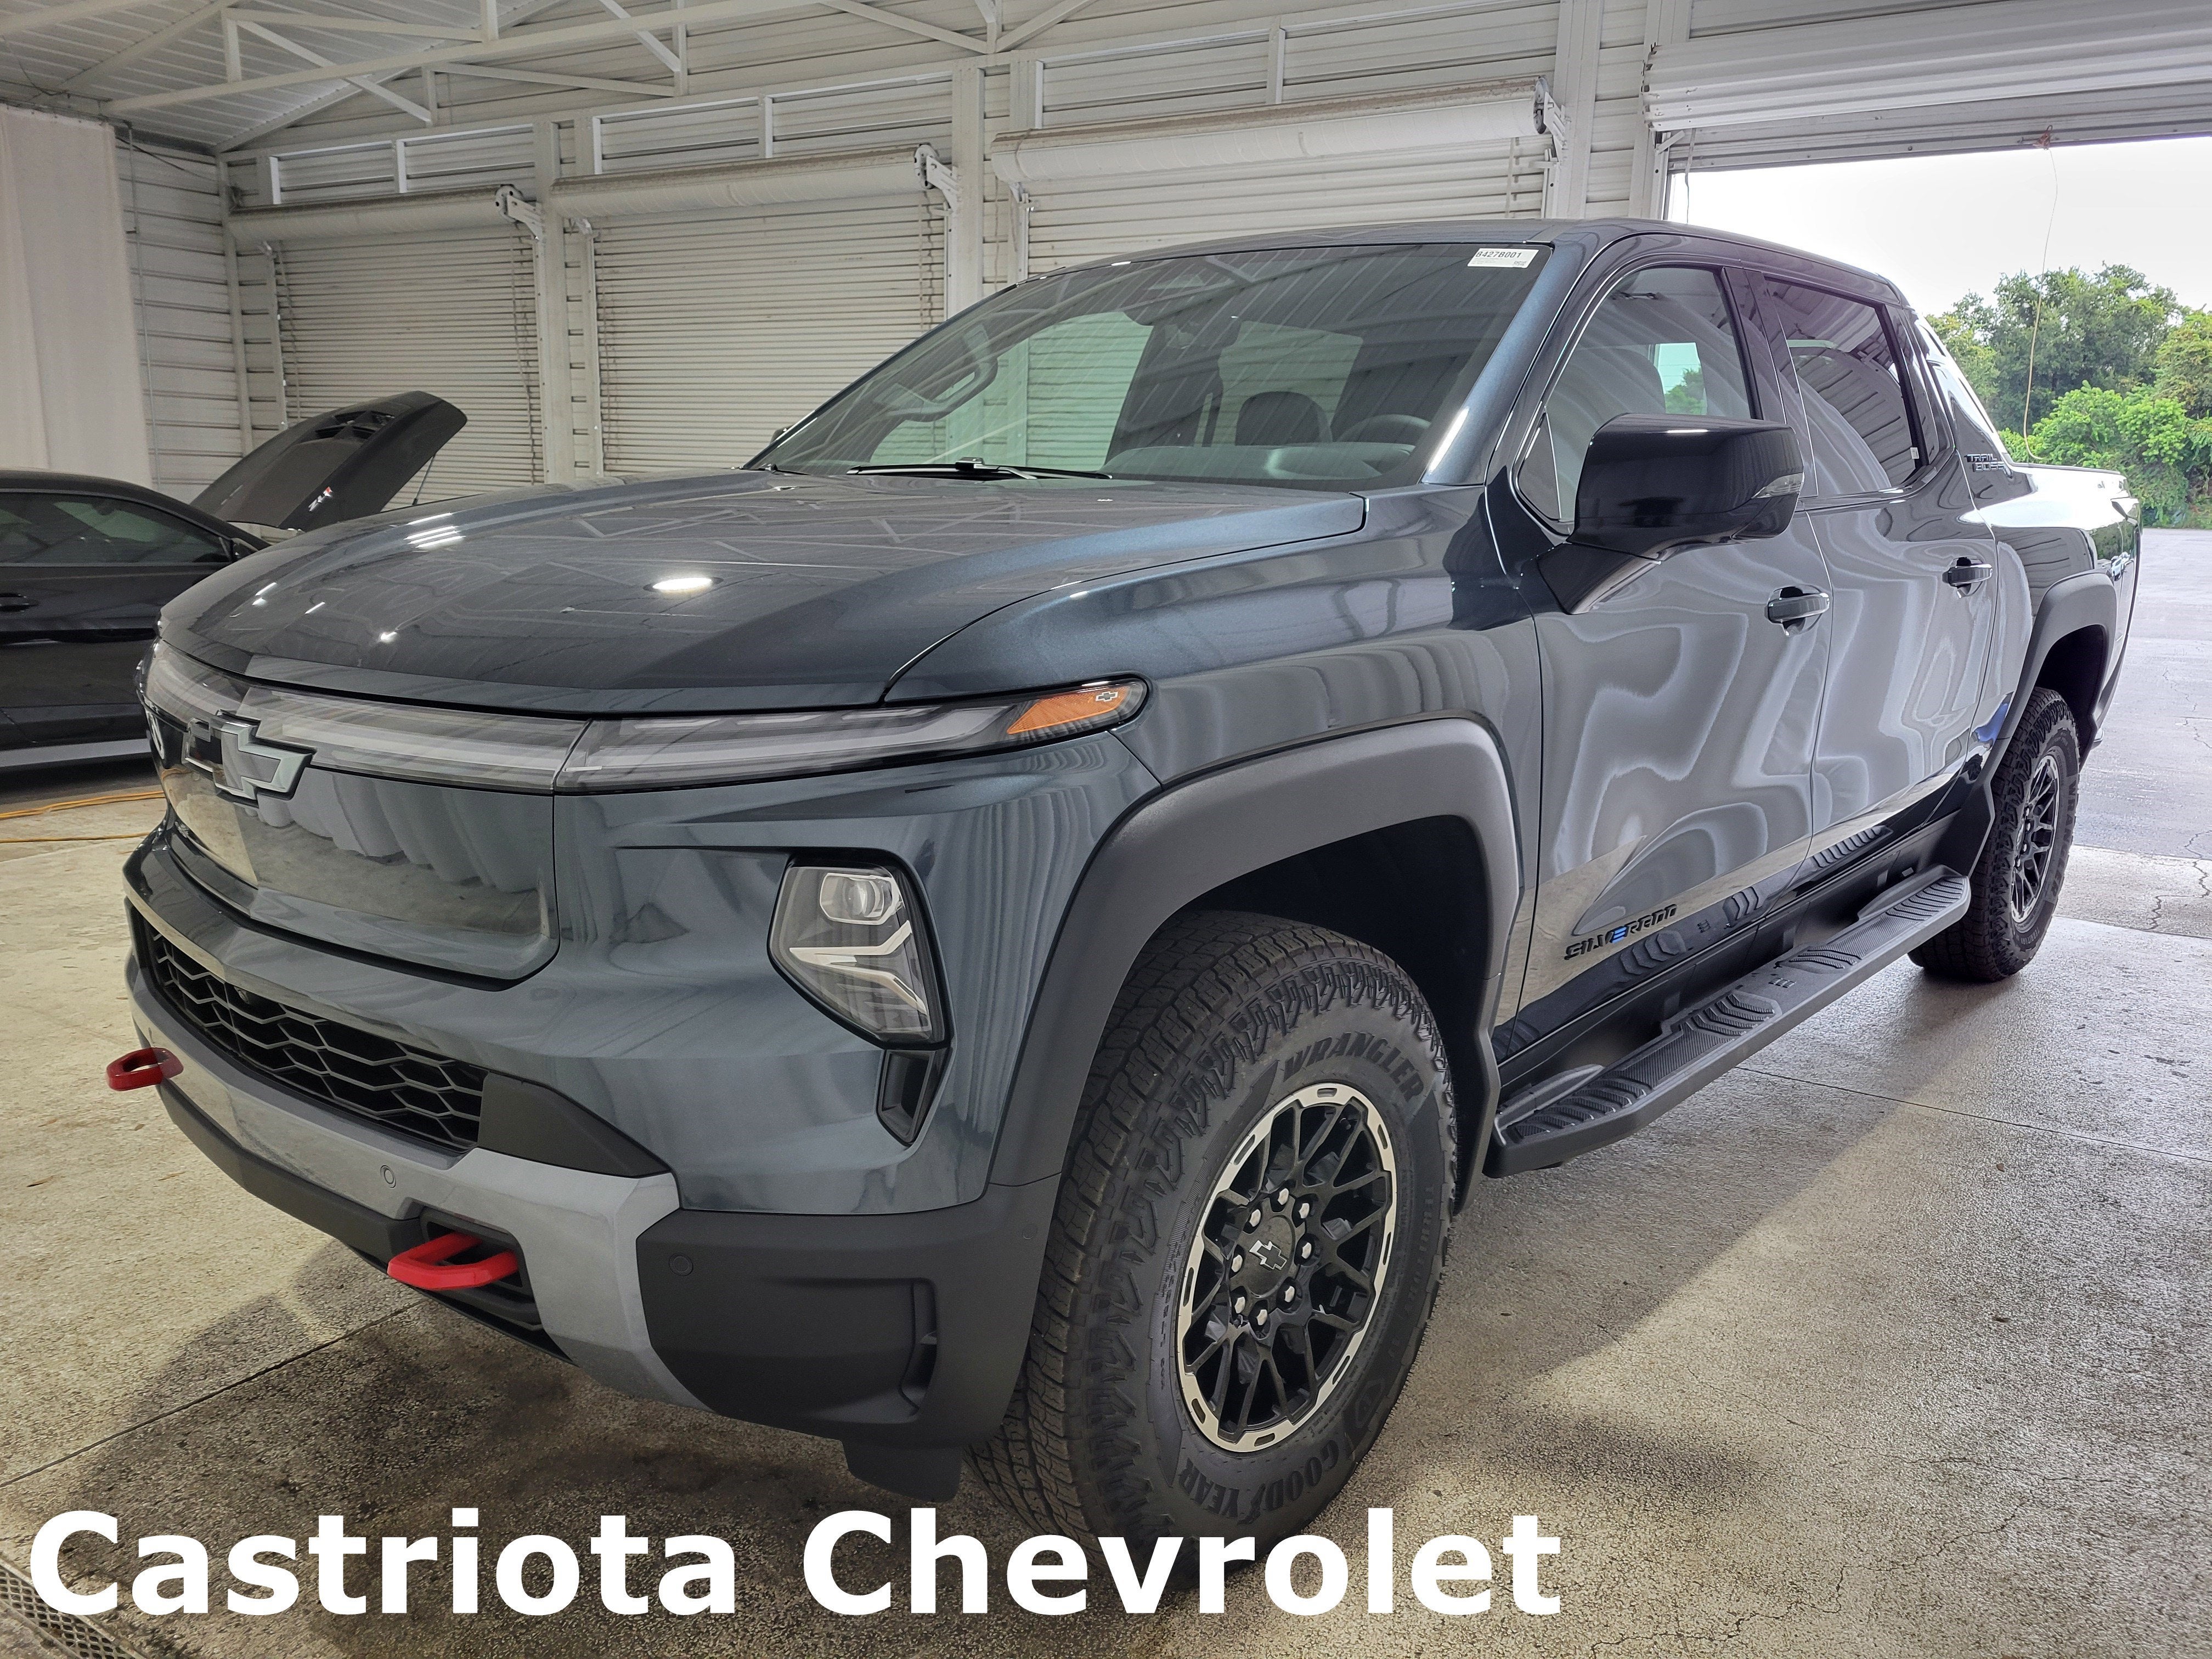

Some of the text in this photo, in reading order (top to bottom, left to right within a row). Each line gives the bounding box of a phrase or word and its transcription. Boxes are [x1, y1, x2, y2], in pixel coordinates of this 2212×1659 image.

[1965, 453, 1997, 462] TRAIL
[1972, 461, 2005, 472] BOSS
[2051, 779, 2076, 897] WRANGLER
[1564, 904, 1678, 961] SILVERADO
[1283, 1031, 1424, 1102] WRANGLER
